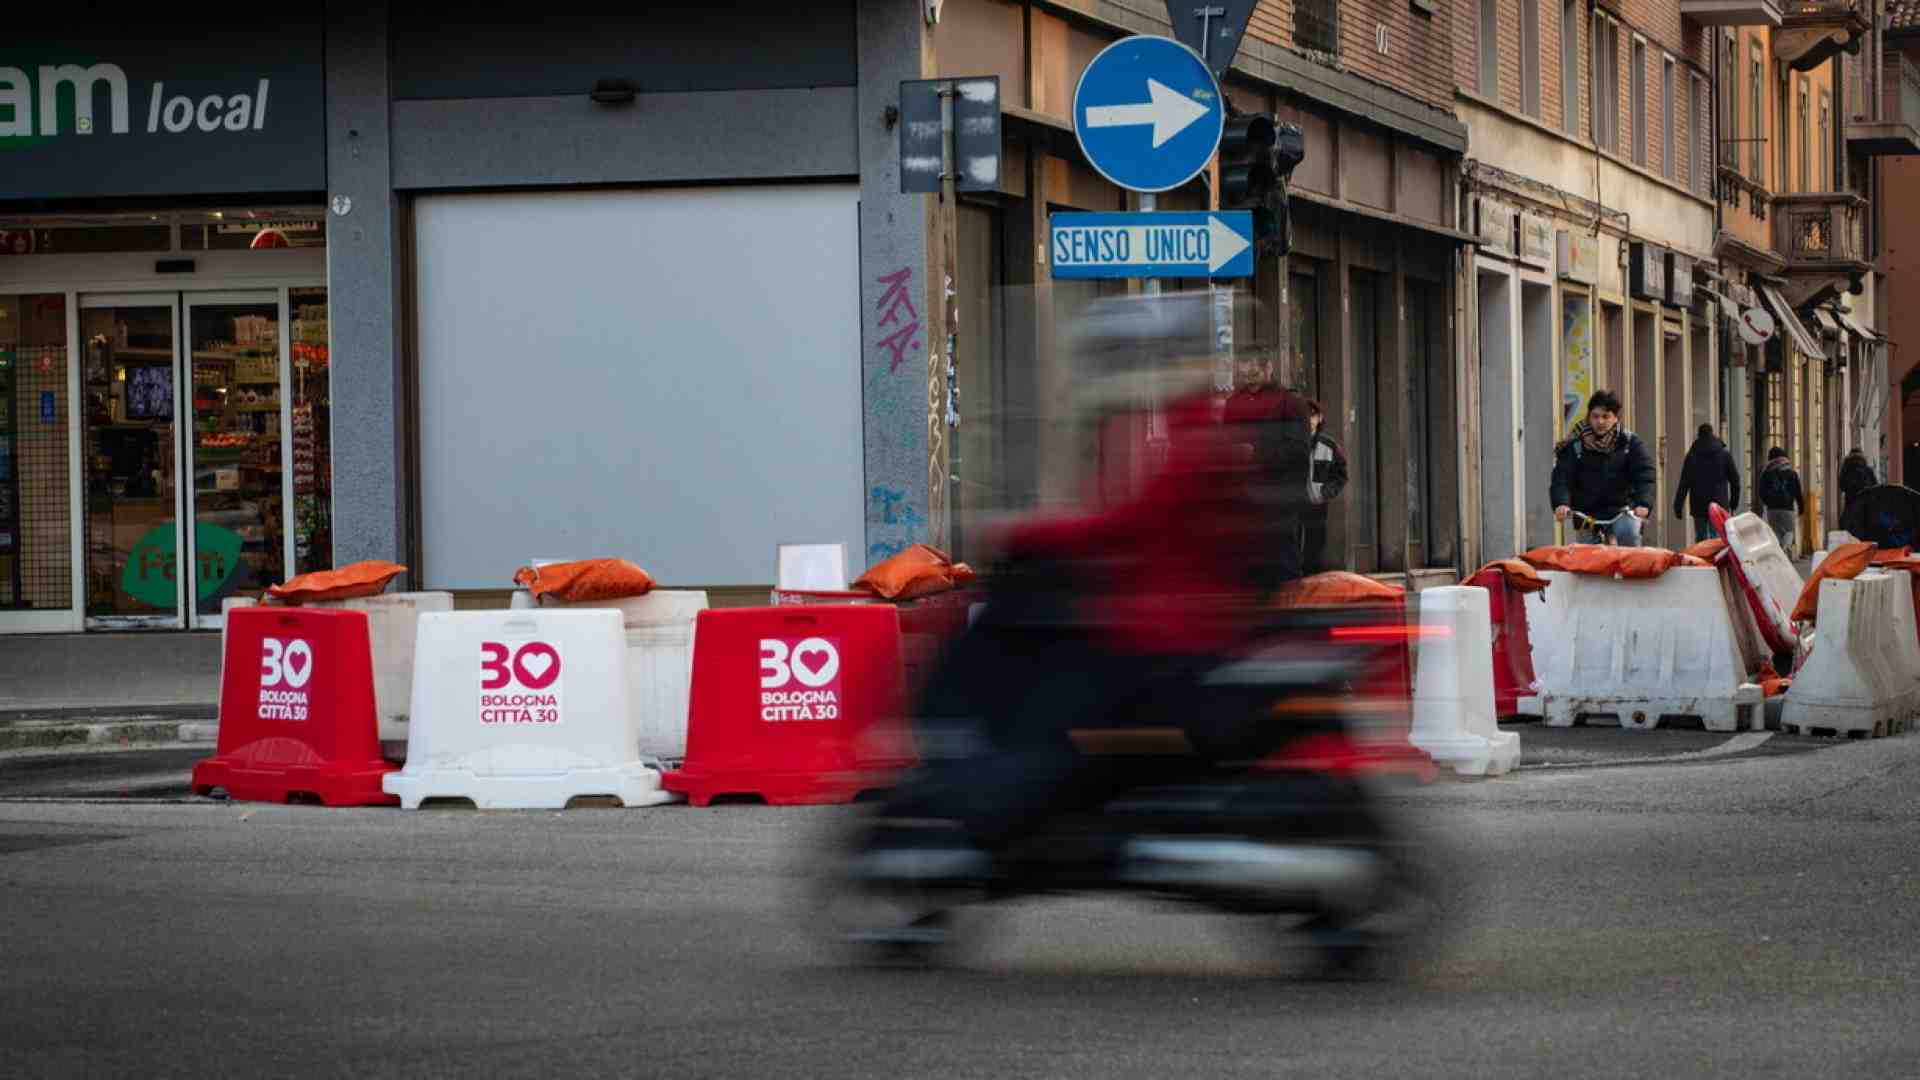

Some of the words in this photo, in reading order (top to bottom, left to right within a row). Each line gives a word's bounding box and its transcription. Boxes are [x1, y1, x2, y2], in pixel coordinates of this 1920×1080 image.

[147, 79, 269, 133] local
[1056, 228, 1130, 264] SENSO
[1145, 226, 1211, 262] UNICO
[261, 637, 312, 688] 30
[481, 641, 561, 689] 30
[760, 637, 840, 688] 30
[260, 689, 308, 704] BOLOGNA
[481, 695, 557, 706] BOLOGNA
[761, 690, 838, 704] BOLOGNA
[258, 702, 292, 719] CITTÀ
[294, 705, 308, 720] 30
[481, 706, 533, 722] CITTÀ
[535, 708, 558, 722] 30
[761, 702, 813, 720] CITTÀ
[815, 704, 838, 719] 30
